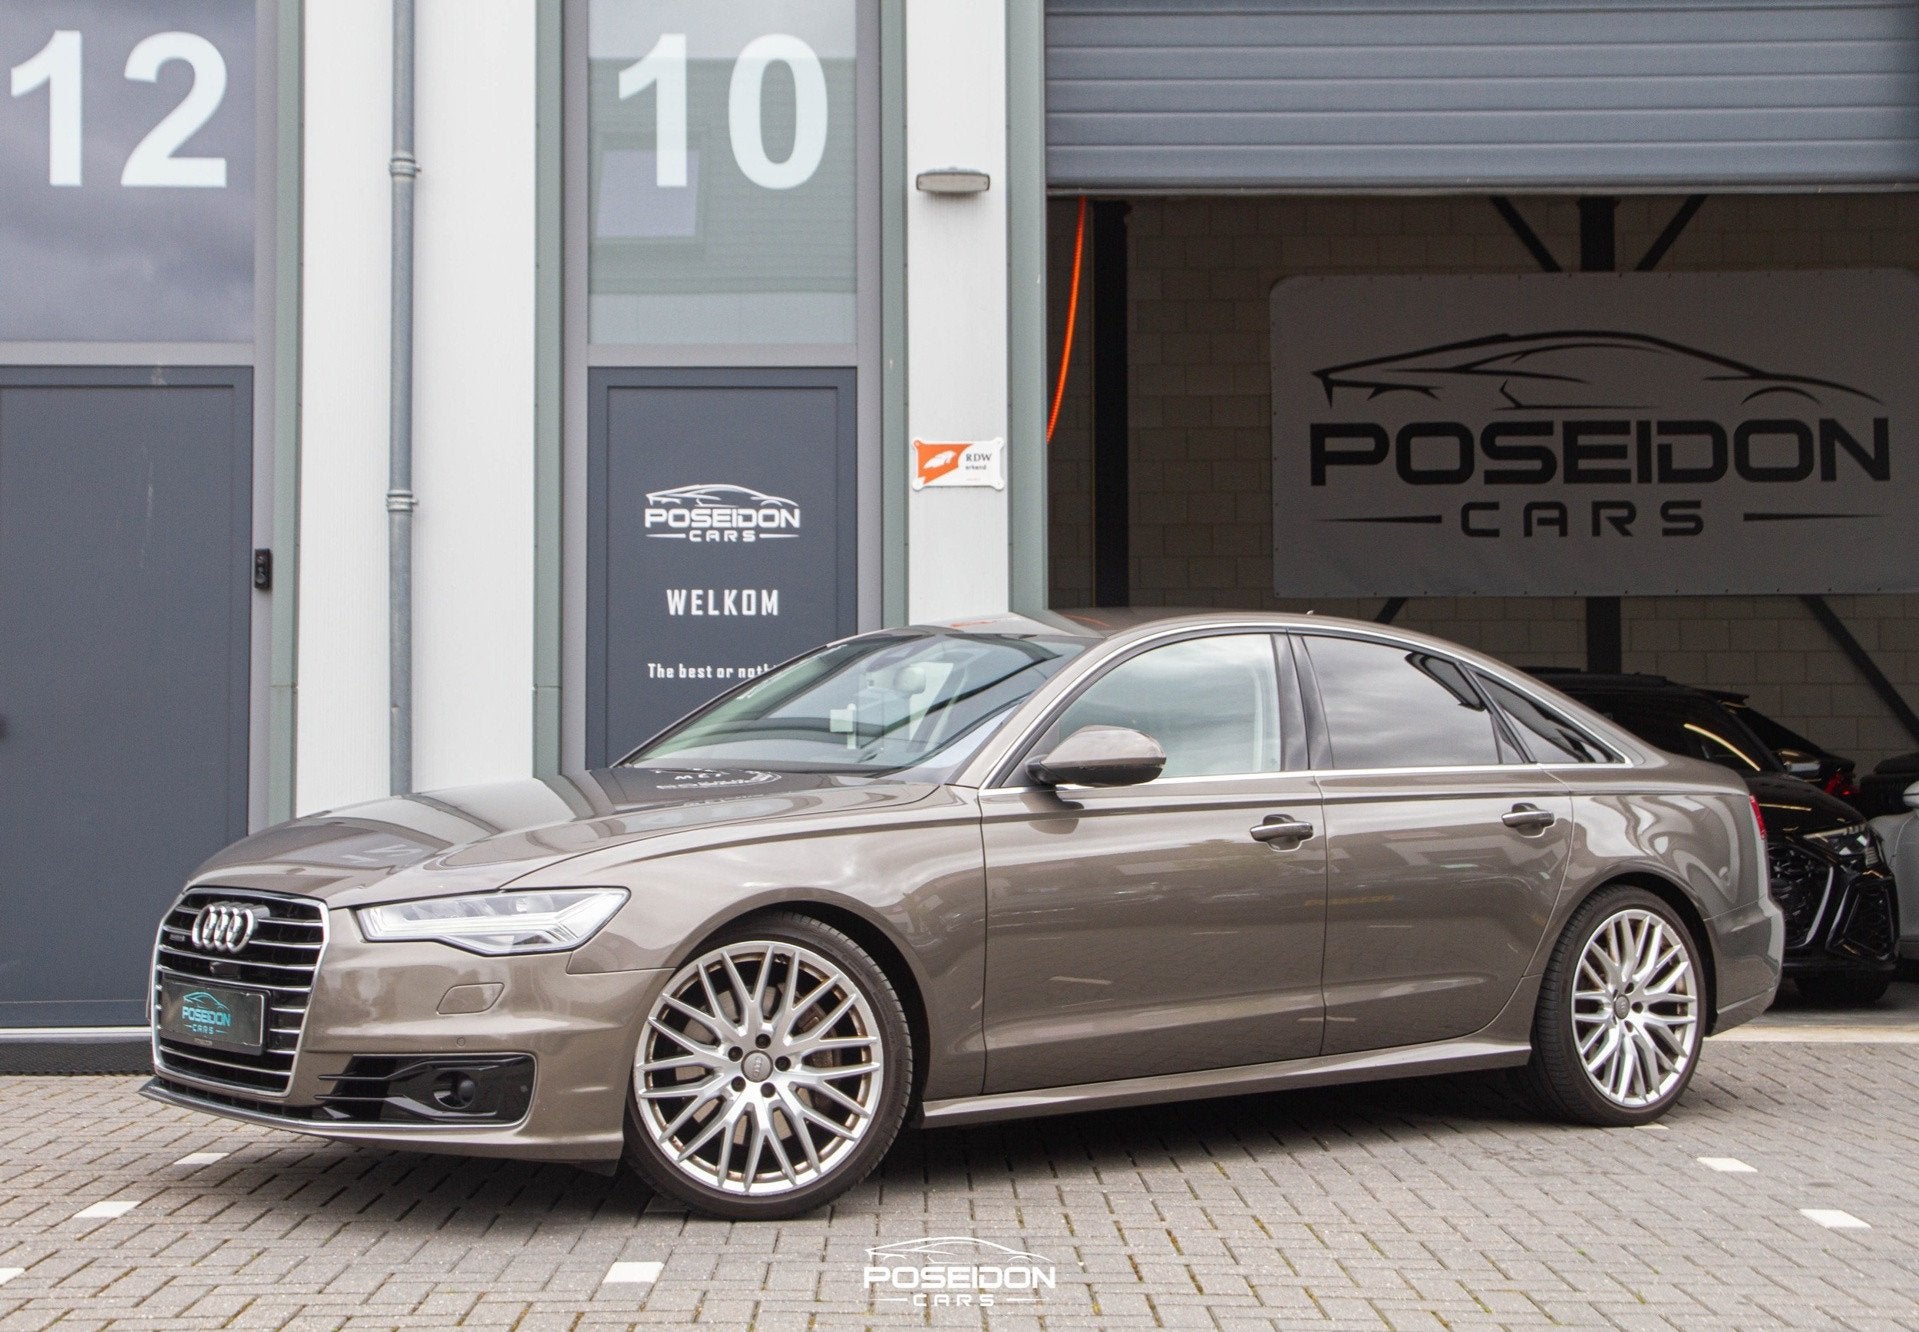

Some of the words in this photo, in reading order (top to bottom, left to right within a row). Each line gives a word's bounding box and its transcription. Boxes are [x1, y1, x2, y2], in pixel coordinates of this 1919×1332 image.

[10, 30, 228, 189] 12
[619, 33, 828, 190] 10
[965, 453, 992, 462] RDW
[1310, 417, 1891, 486] POSEIDON
[644, 508, 800, 528] POSEIDON
[1460, 500, 1705, 538] CARS
[689, 530, 756, 542] CARS
[667, 589, 779, 616] WELKOM
[647, 663, 674, 678] The
[678, 663, 713, 678] best
[716, 667, 734, 678] or
